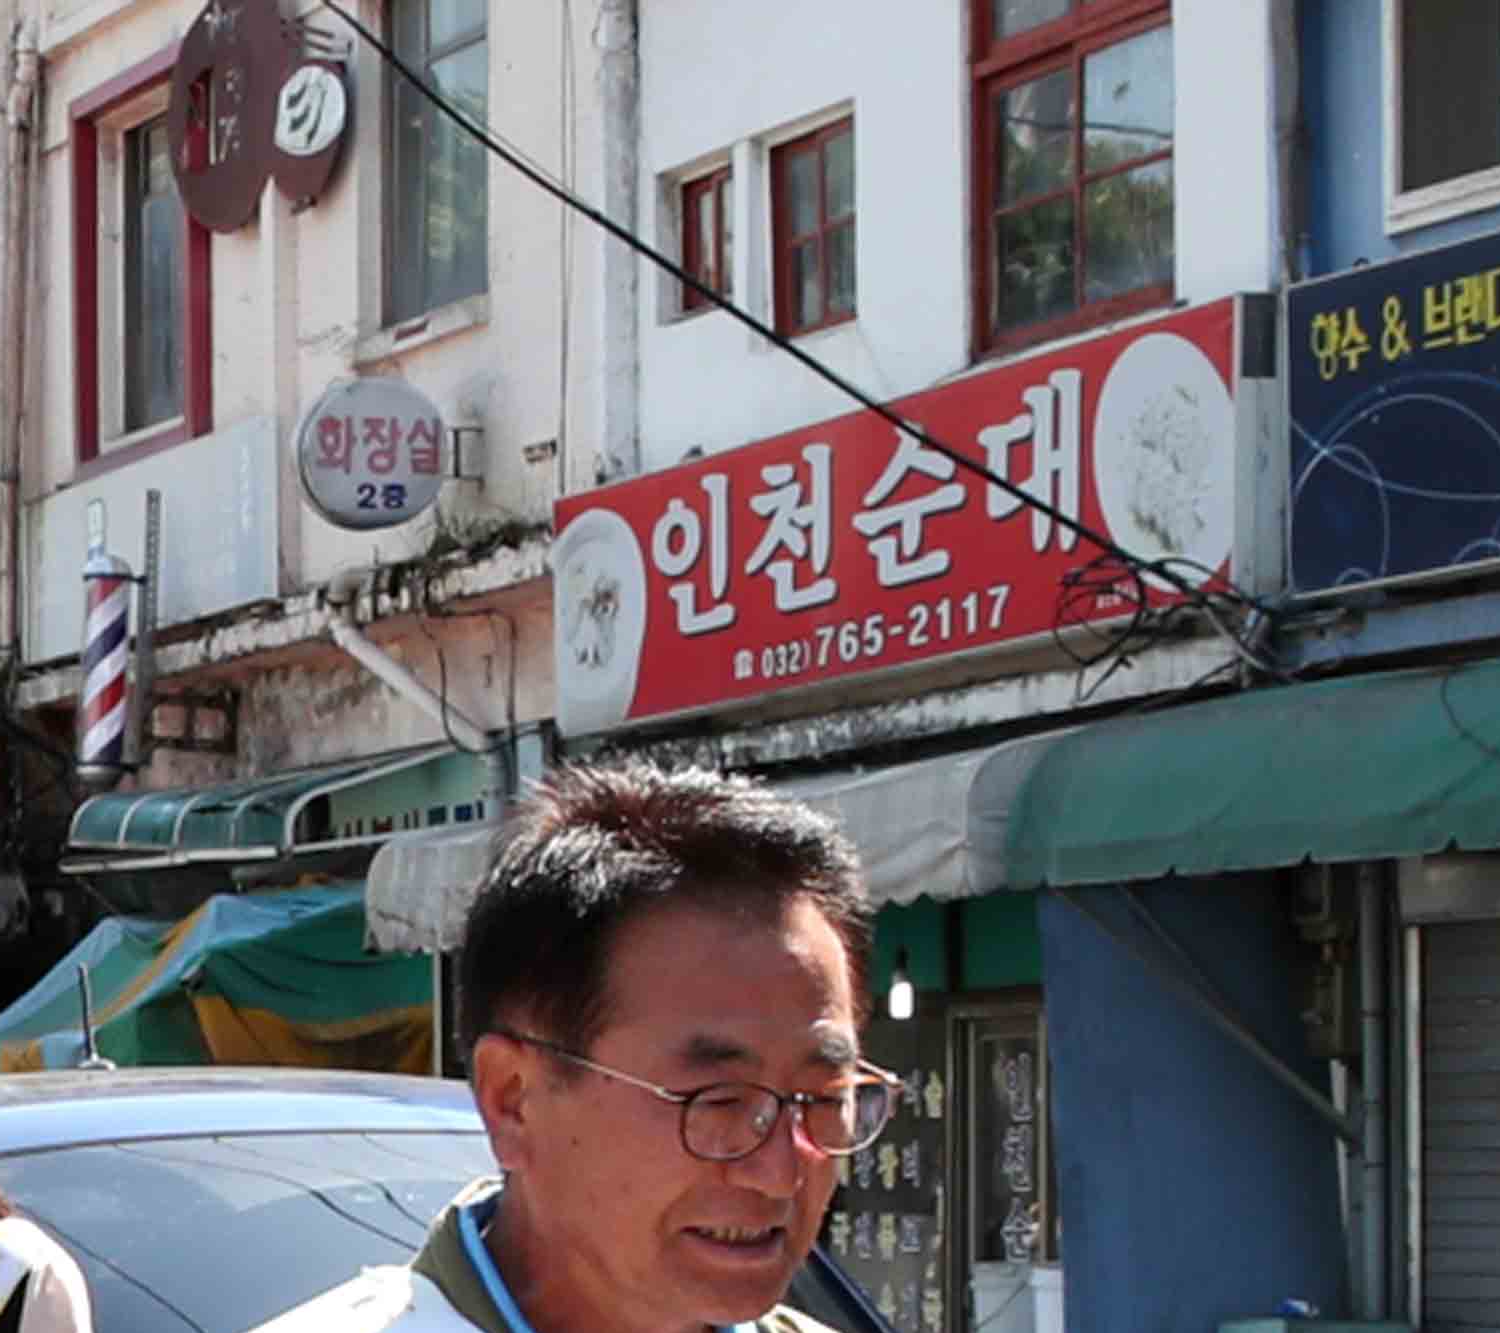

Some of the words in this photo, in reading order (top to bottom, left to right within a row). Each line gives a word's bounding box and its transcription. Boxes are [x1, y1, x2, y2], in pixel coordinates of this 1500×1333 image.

[1381, 299, 1409, 360] &
[315, 415, 443, 477] 화장실
[651, 366, 1084, 637] 인천순대
